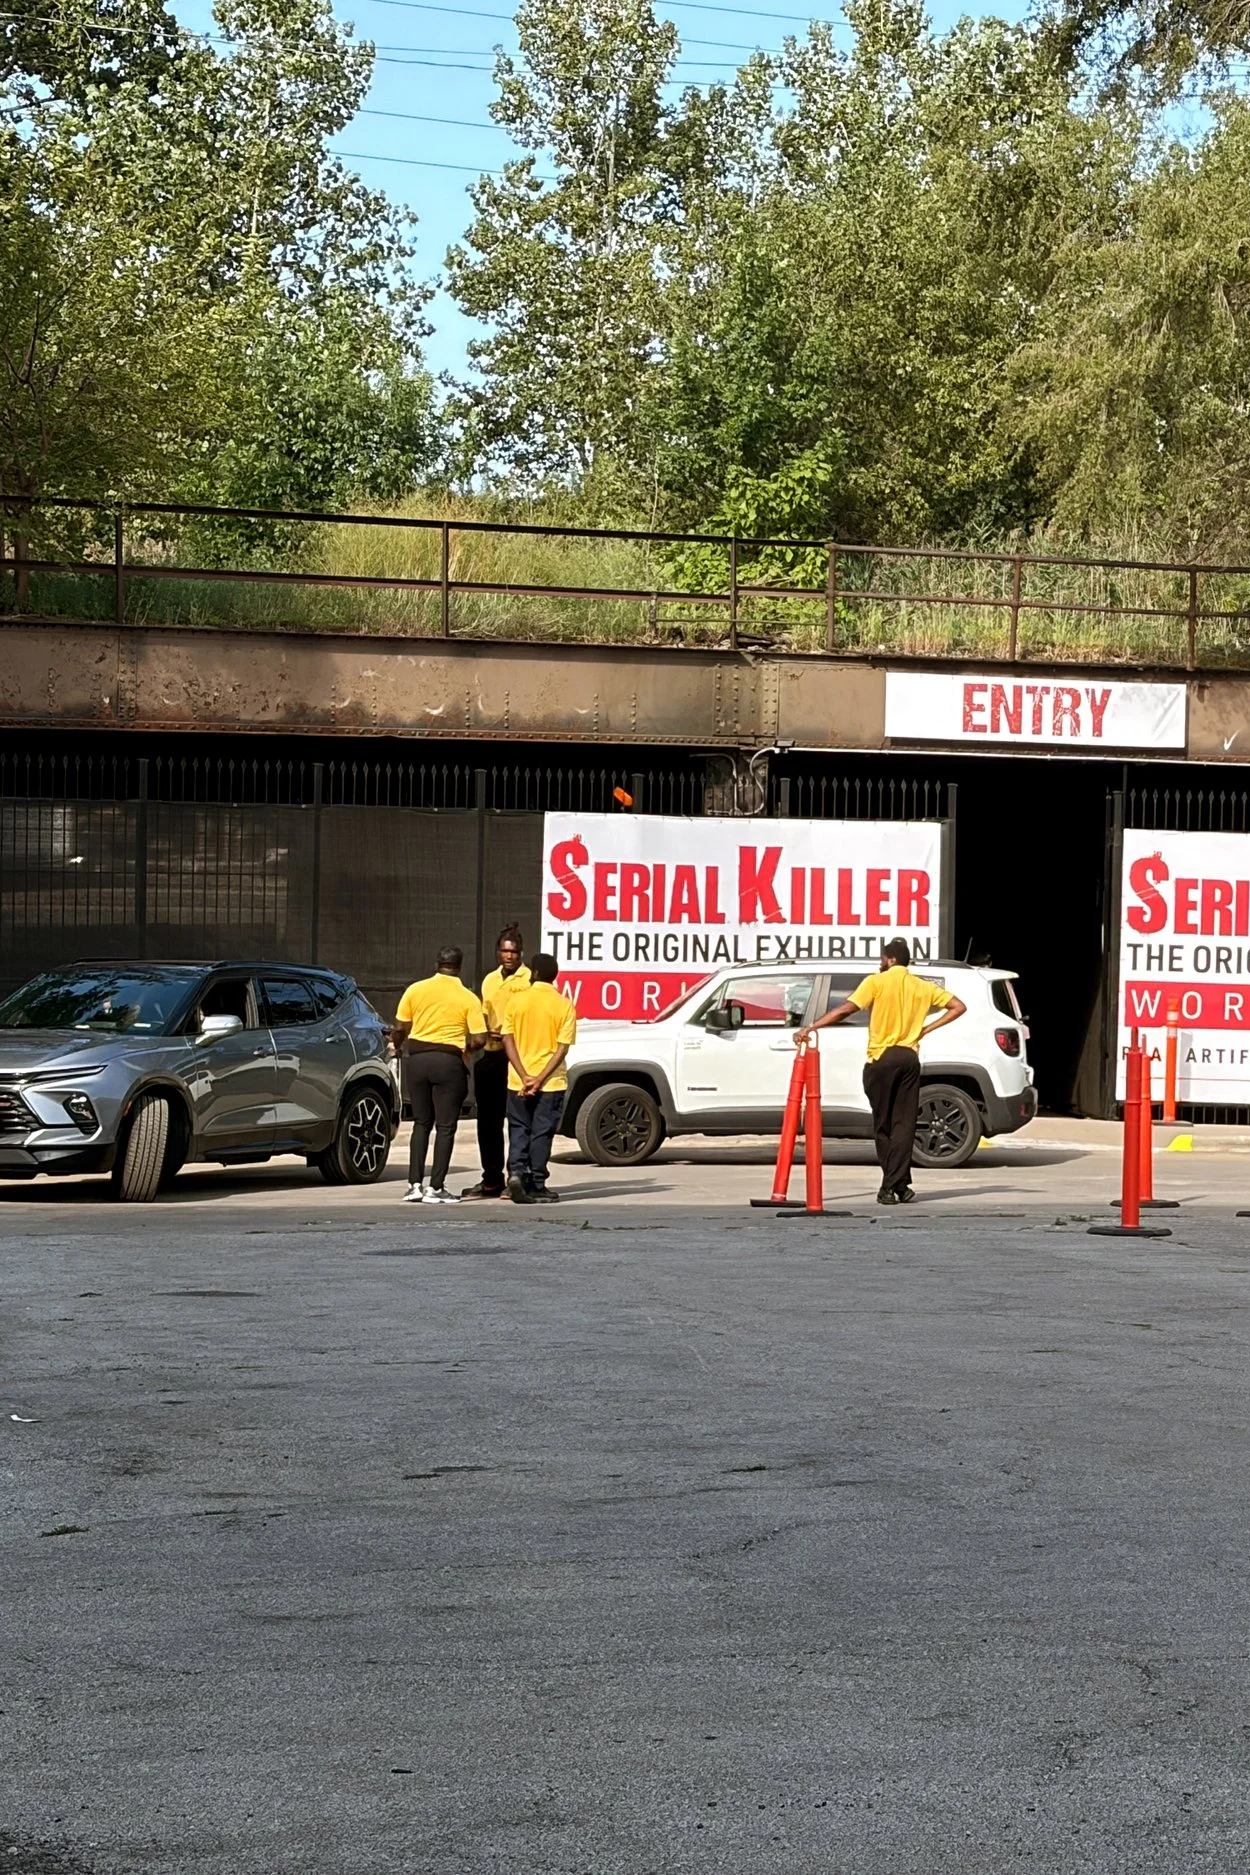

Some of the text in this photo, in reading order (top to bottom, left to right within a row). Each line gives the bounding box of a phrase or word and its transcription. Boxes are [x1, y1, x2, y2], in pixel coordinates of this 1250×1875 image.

[962, 683, 1112, 738] ENTRY
[547, 833, 931, 927] SERIAL KILLER
[548, 932, 931, 963] THE ORIGINAL EXHIBITIN
[1127, 943, 1184, 972] THE
